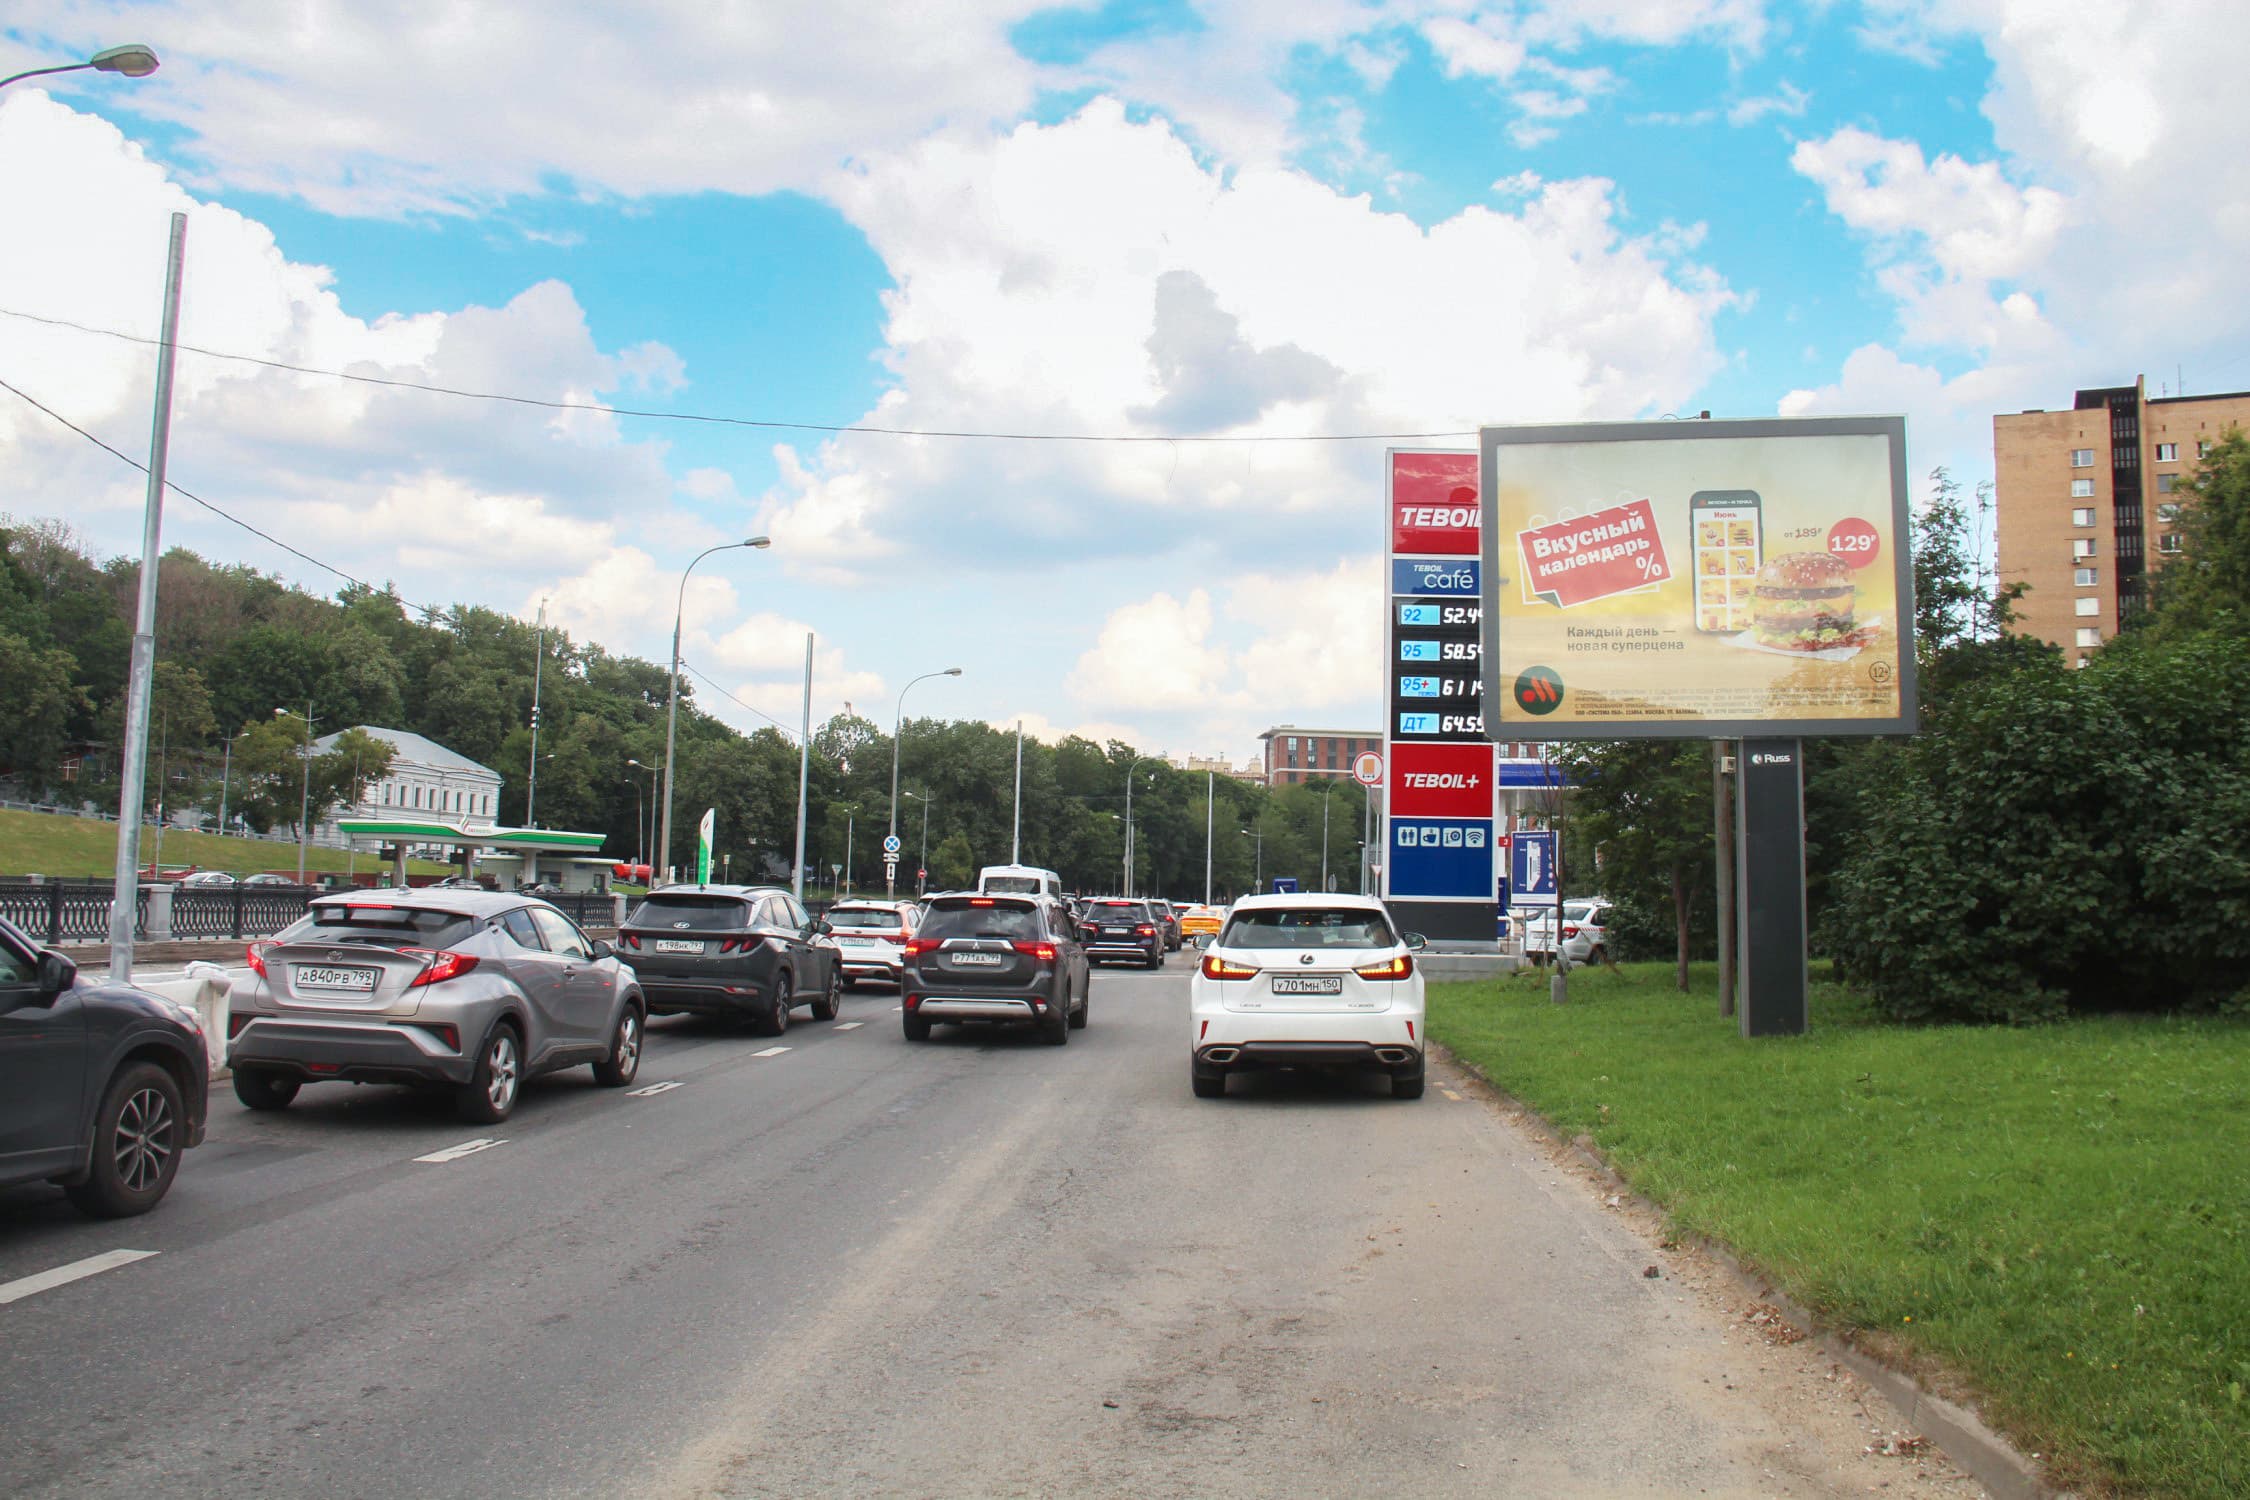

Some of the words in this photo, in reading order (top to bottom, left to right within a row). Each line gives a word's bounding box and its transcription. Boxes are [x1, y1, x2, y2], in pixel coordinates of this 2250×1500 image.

[1401, 507, 1482, 528] TEBOIL
[1533, 510, 1646, 558] Вкусный
[1539, 537, 1650, 577] календарь
[1413, 564, 1443, 572] TEBOIL
[1635, 552, 1662, 580] %
[1423, 569, 1474, 589] café
[1403, 608, 1422, 622] 92
[1567, 626, 1623, 638] Каждый
[1626, 626, 1660, 638] день
[1403, 644, 1422, 657] 95
[1567, 642, 1608, 652] новая
[1611, 641, 1685, 653] суперцена
[1403, 678, 1430, 691] 95+
[1403, 716, 1427, 732] ДТ
[1764, 753, 1791, 763] Russ
[1404, 773, 1480, 789] TEBOIL+
[301, 969, 349, 984] А840РВ
[352, 970, 372, 982] 799
[1276, 980, 1319, 991] У701МН
[1322, 979, 1338, 989] 150
